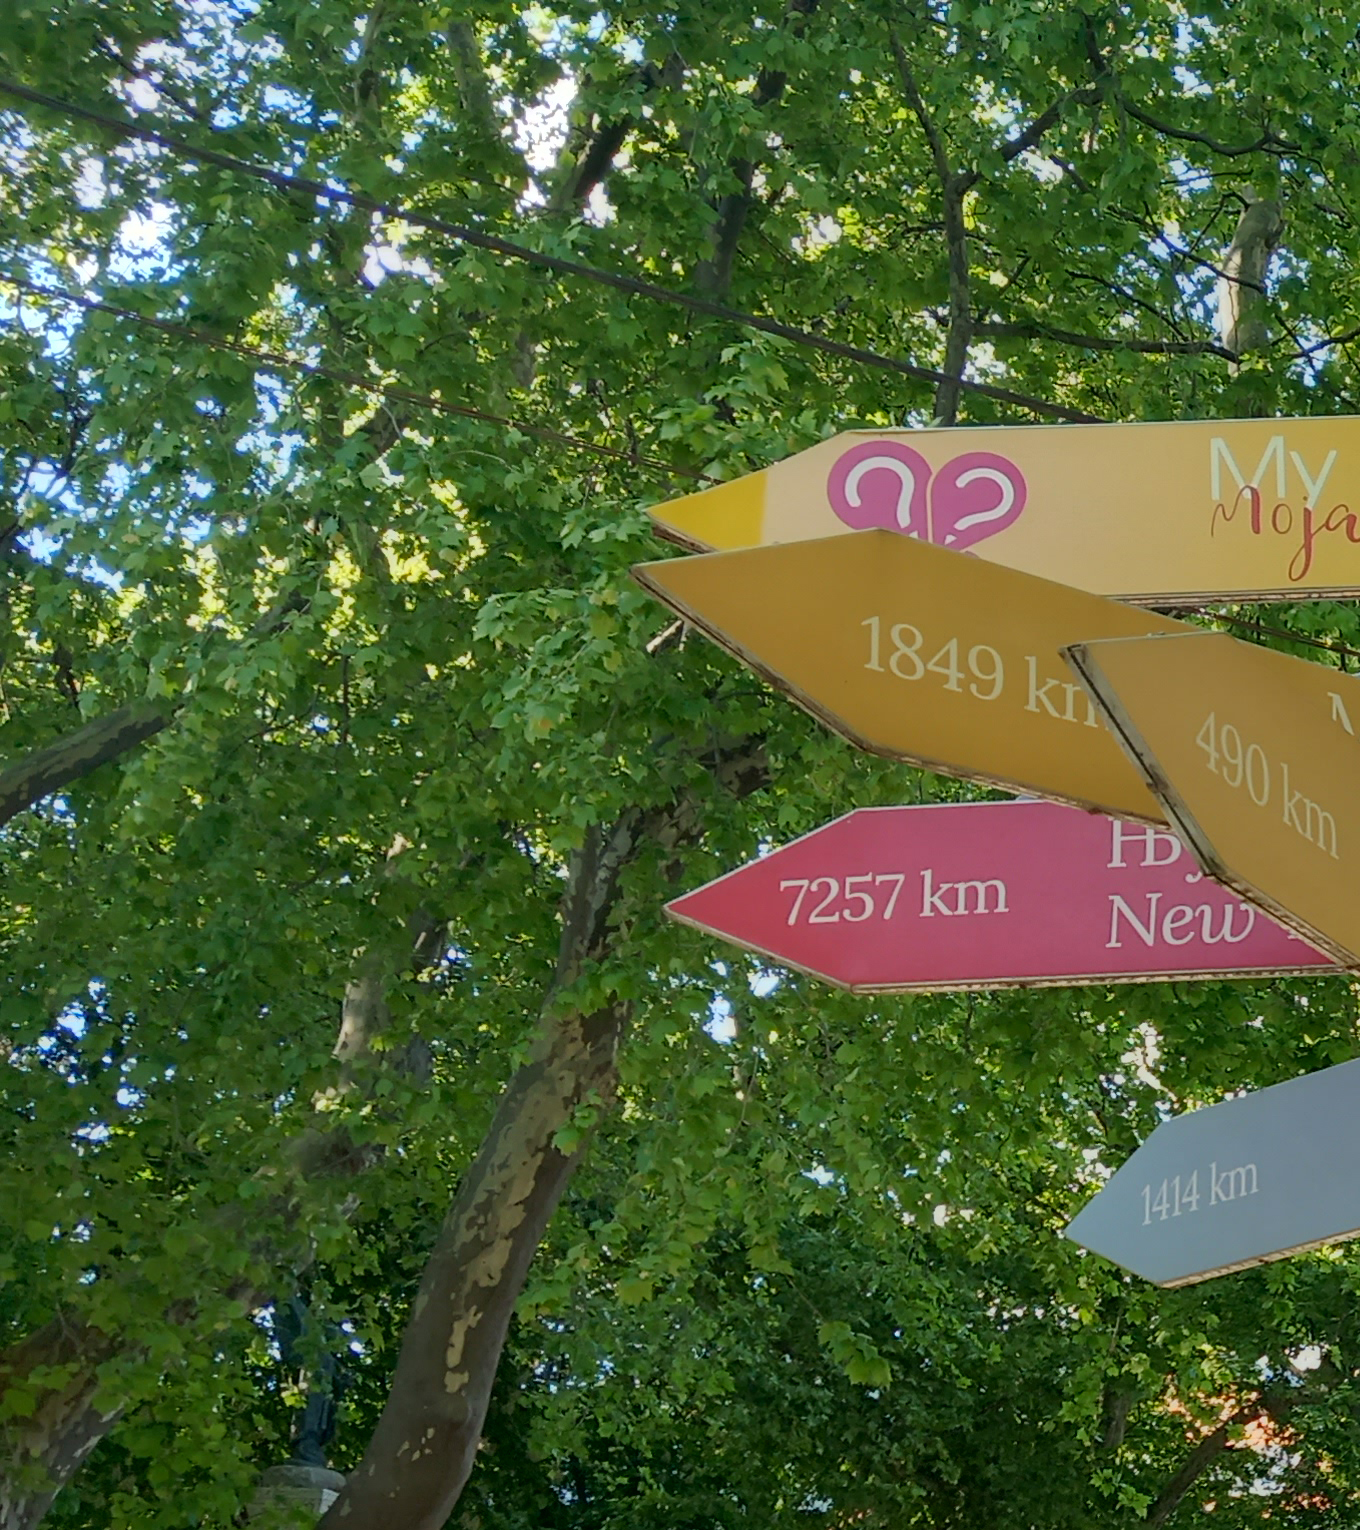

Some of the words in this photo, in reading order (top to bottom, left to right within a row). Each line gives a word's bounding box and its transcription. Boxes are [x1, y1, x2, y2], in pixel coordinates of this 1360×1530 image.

[1209, 435, 1338, 511] My
[860, 615, 1005, 700] 1849
[1196, 711, 1270, 807] 490
[1280, 762, 1340, 860] km
[779, 871, 905, 926] 7257
[919, 869, 1010, 917] km
[1105, 893, 1256, 949] New
[1141, 1168, 1200, 1226] 1414
[1208, 1161, 1260, 1206] km
